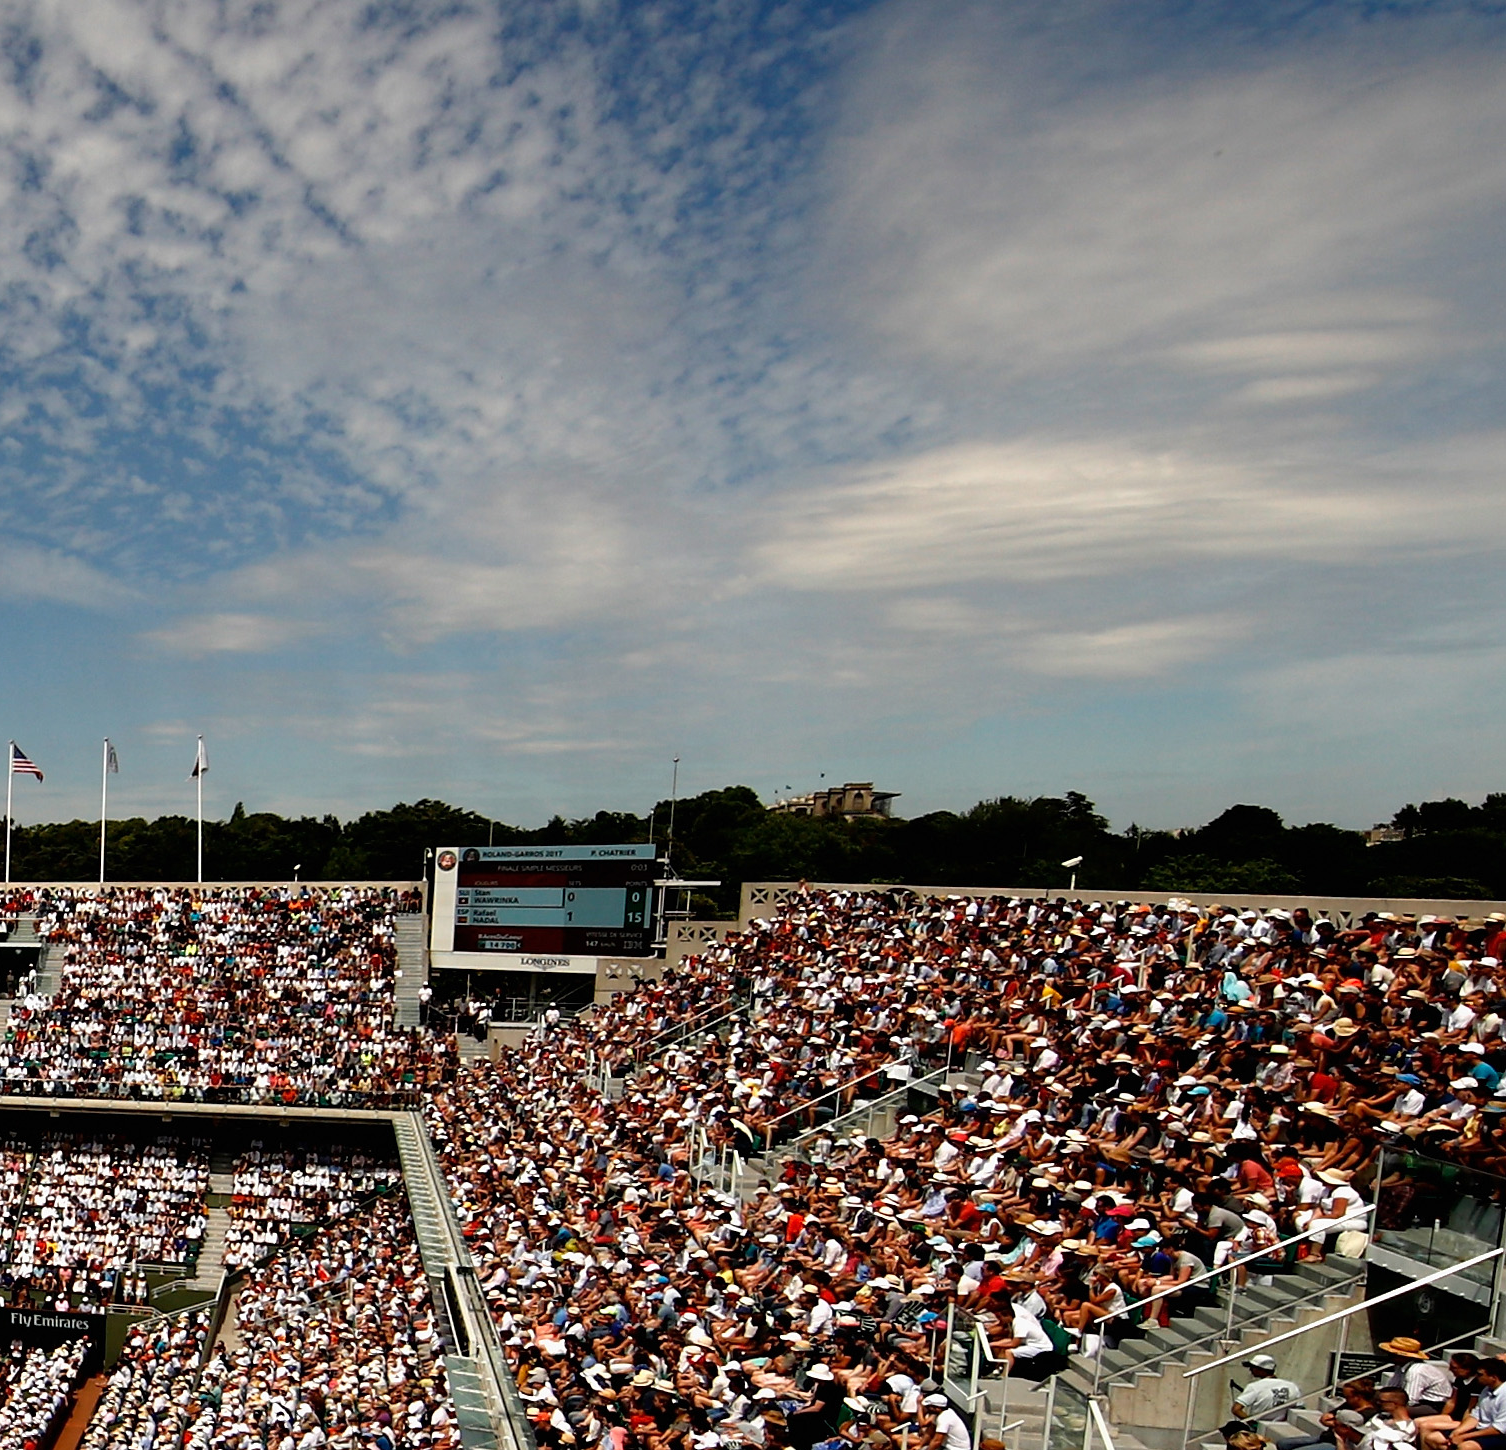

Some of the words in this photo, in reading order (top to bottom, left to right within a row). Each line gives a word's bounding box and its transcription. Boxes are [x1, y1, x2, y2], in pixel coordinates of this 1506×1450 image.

[482, 850, 544, 858] ROLAND-GARROS
[545, 850, 563, 858] 2017
[598, 849, 637, 857] CHATRIER
[474, 896, 519, 904] WAWRINKA
[567, 892, 575, 902] 0
[632, 892, 640, 902] 0
[473, 916, 499, 924] NADAL
[567, 911, 573, 921] 1
[627, 912, 642, 923] 15
[623, 940, 643, 949] IBM
[520, 957, 570, 967] LONGINES
[11, 1312, 32, 1328] Fly
[33, 1312, 89, 1330] Emirates
